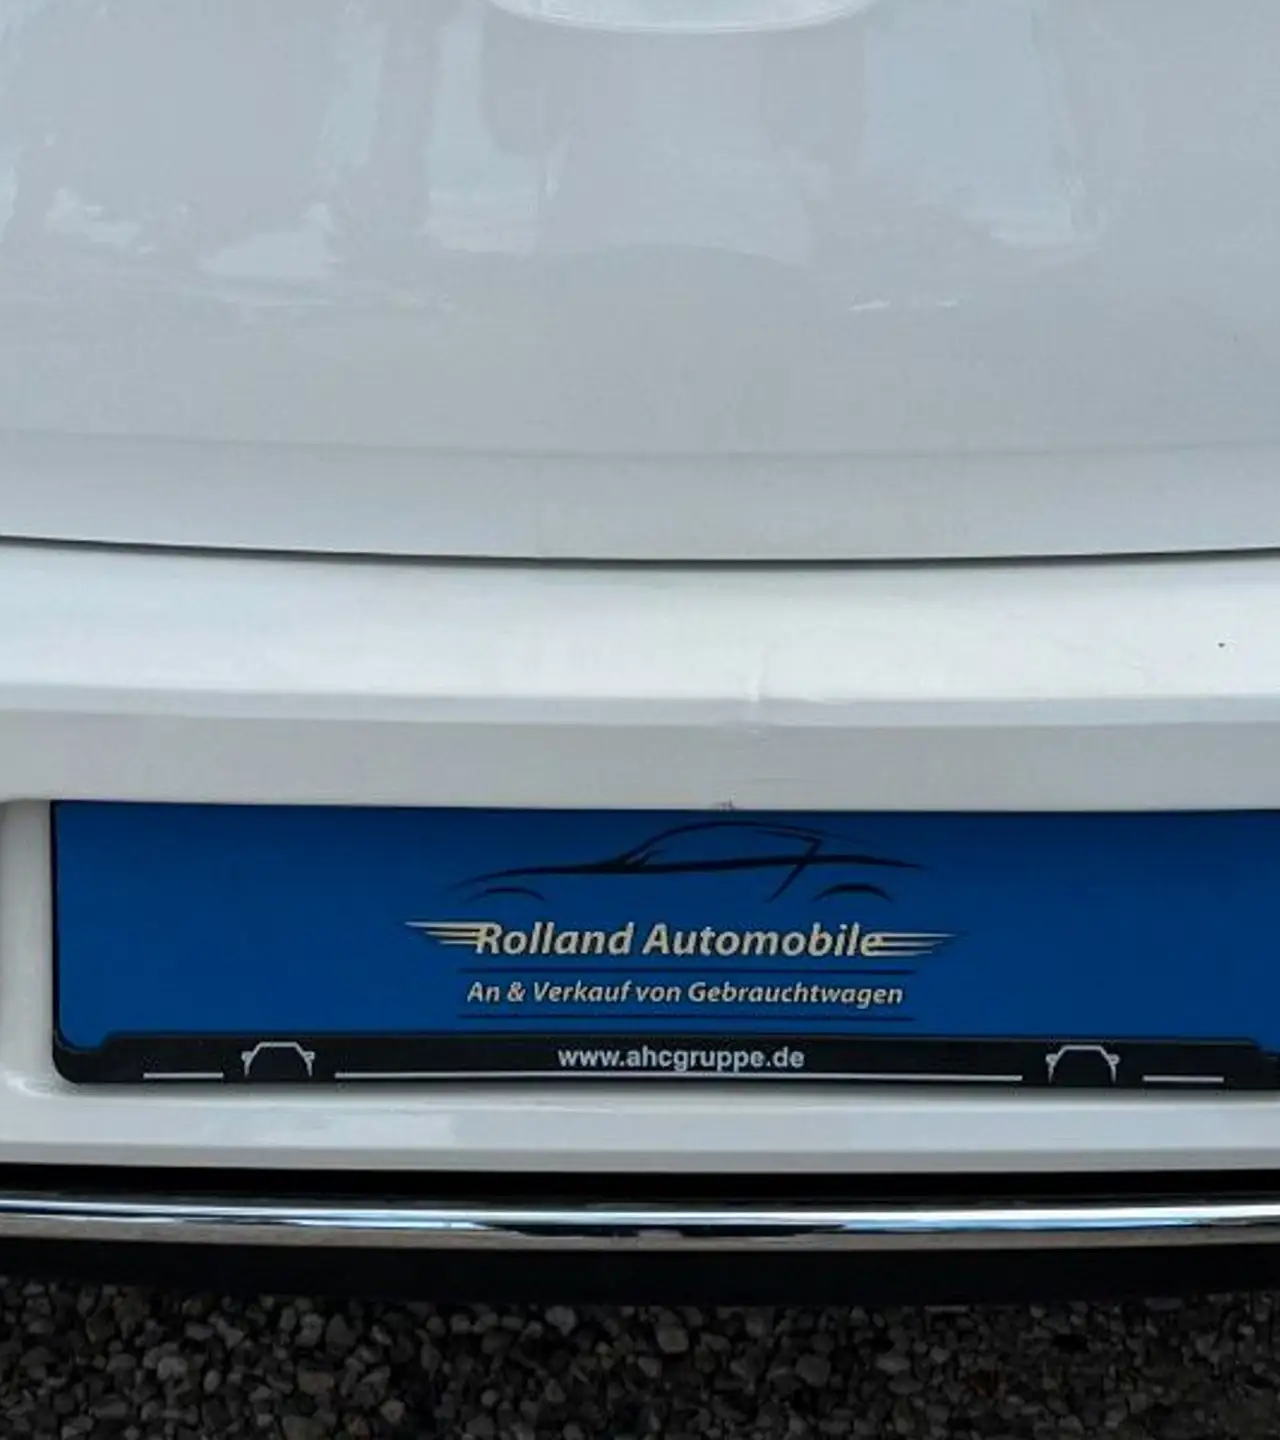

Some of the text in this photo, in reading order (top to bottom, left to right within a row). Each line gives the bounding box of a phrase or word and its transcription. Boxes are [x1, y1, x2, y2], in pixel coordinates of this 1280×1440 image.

[474, 921, 886, 957] Rolland Automobile
[467, 980, 904, 1009] An & Verkauf von Gebrauchtwagen
[558, 1045, 805, 1071] www.ahcgruppe.de
